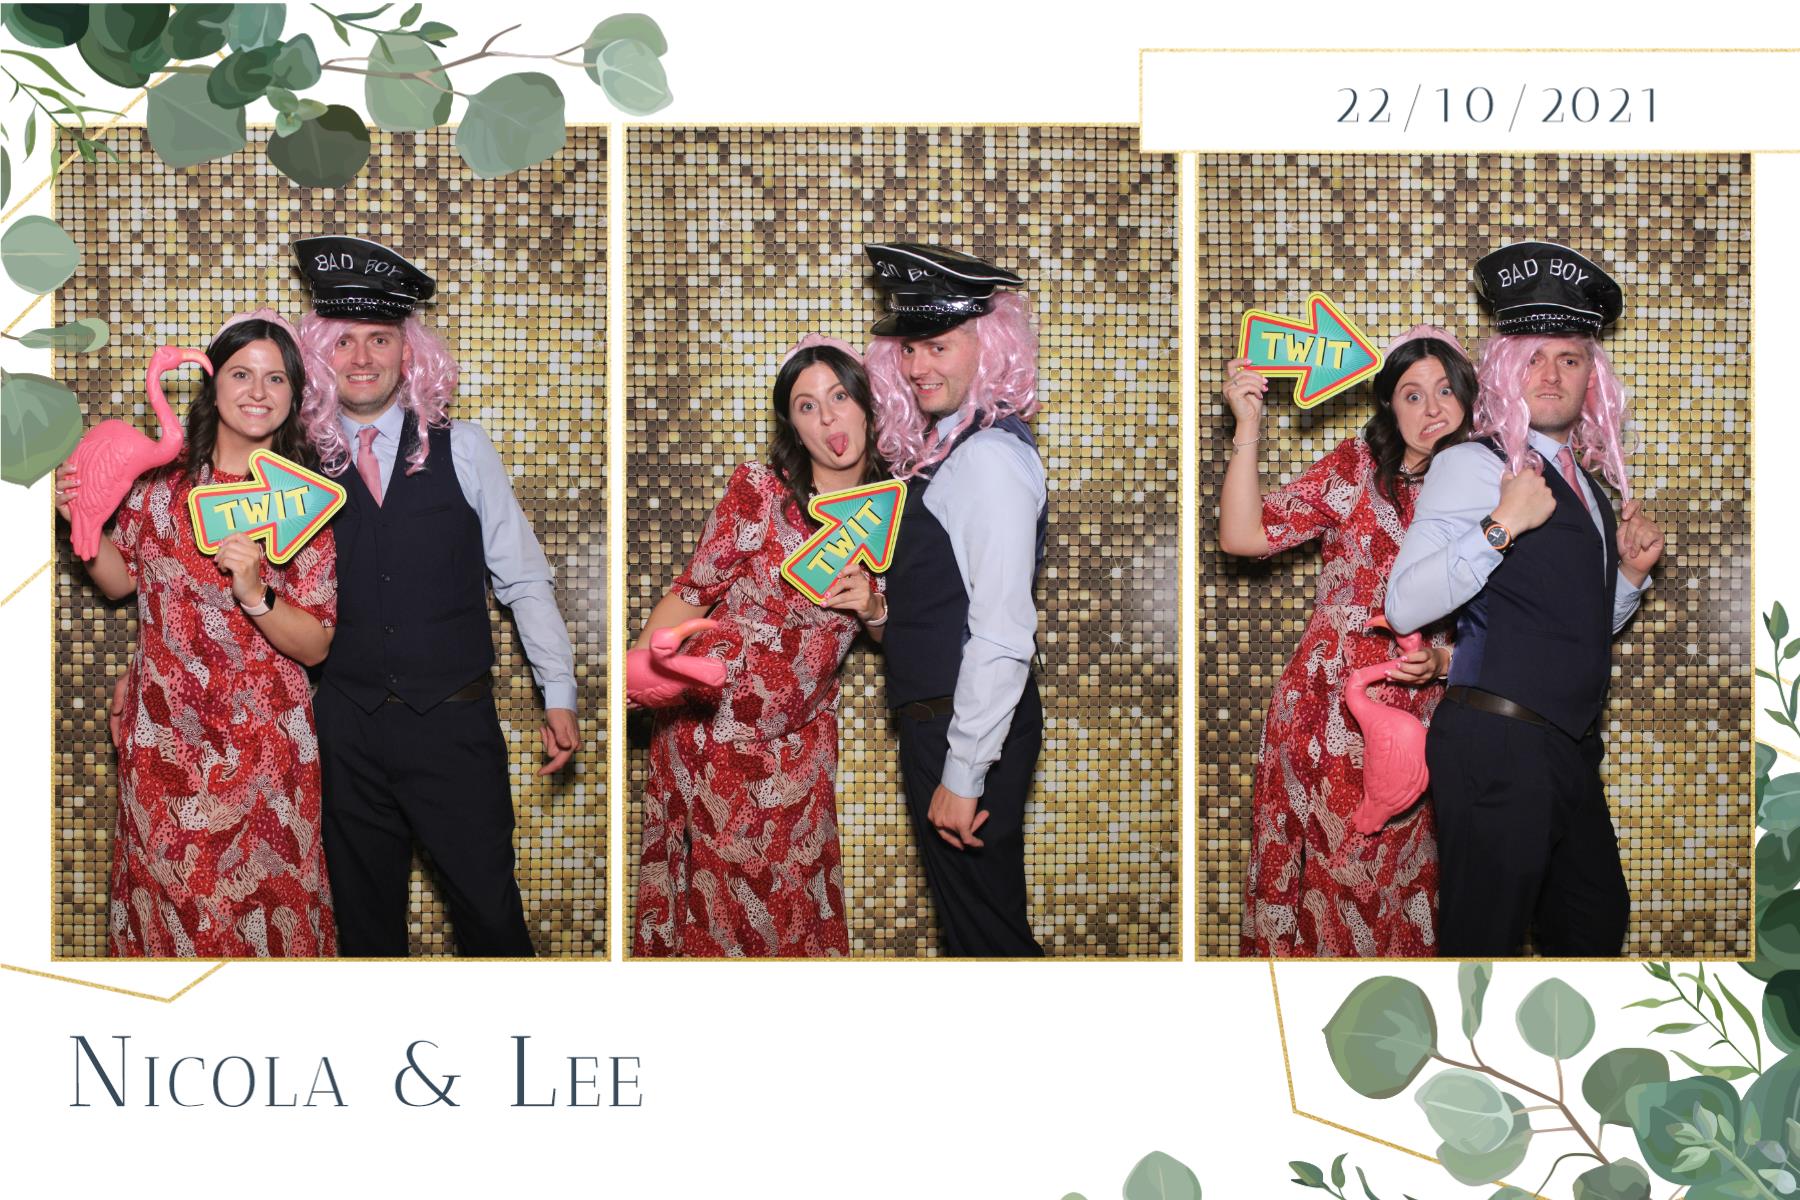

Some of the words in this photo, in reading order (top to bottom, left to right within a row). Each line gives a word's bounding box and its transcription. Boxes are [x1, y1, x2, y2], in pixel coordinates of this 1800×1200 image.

[314, 252, 354, 272] BAD
[364, 259, 403, 277] BOY
[1497, 258, 1539, 288] BAD
[1550, 258, 1589, 286] BOY
[1261, 330, 1353, 370] TWIT
[212, 484, 310, 531] TWIT
[806, 497, 883, 576] TWIT
